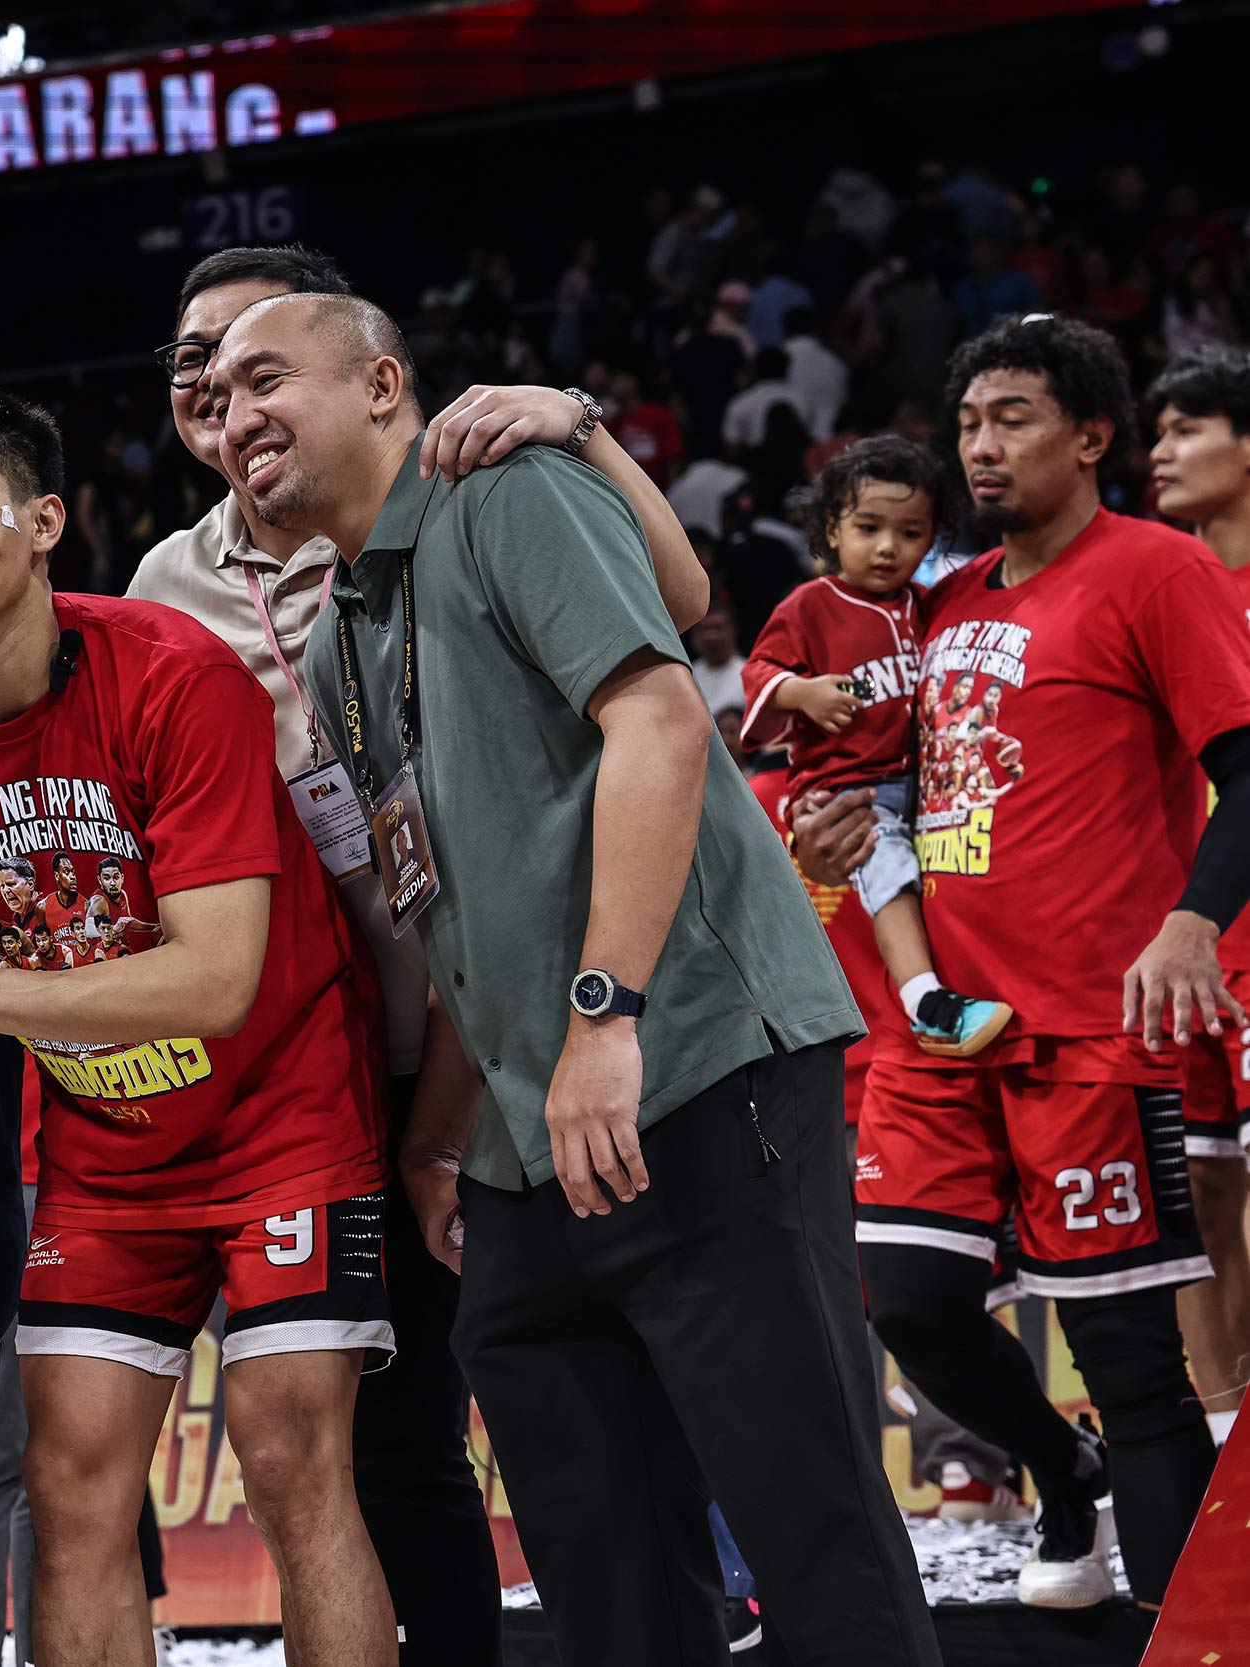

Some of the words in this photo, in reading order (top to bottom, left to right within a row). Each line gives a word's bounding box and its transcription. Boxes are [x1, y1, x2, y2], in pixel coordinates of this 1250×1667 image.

[196, 187, 293, 246] 216
[36, 776, 119, 825] TAPANG
[65, 820, 144, 862] GINEBRA
[396, 870, 429, 913] MEDIA
[1055, 1160, 1142, 1231] 23
[28, 1249, 60, 1260] WORLD
[264, 1206, 314, 1267] 9
